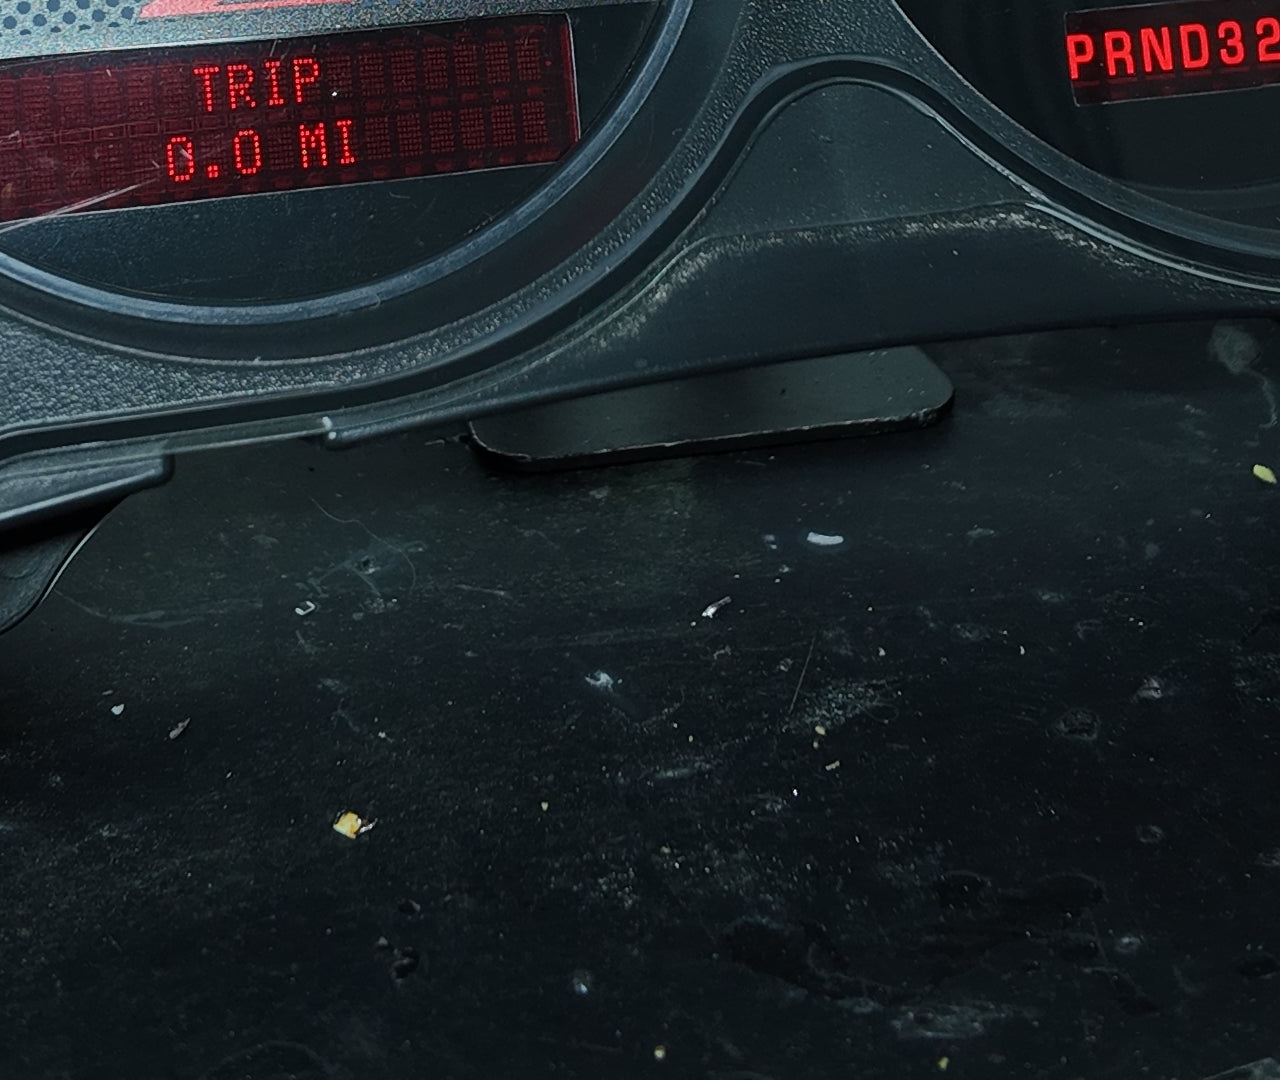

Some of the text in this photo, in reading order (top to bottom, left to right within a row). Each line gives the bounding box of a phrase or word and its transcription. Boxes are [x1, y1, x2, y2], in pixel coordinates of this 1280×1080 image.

[193, 57, 320, 112] TRIP
[165, 119, 356, 183] 0.0 MI
